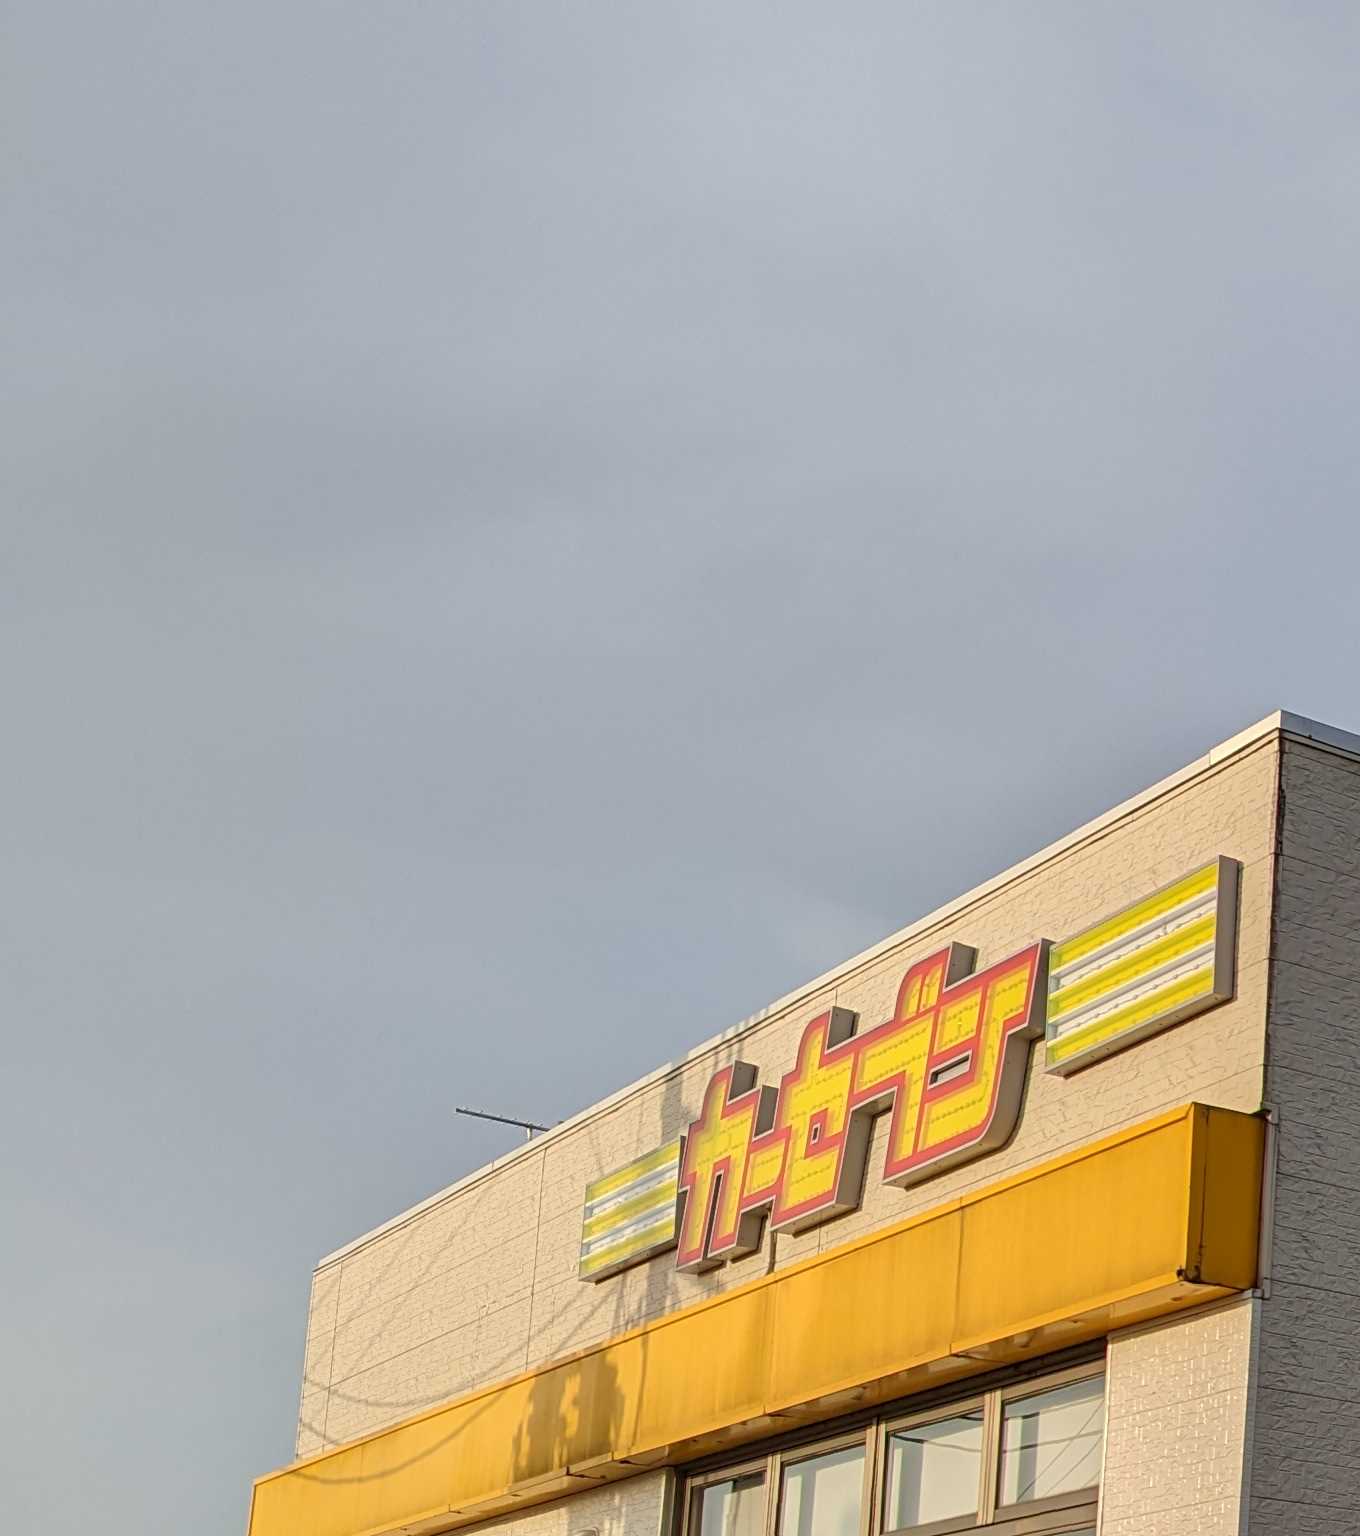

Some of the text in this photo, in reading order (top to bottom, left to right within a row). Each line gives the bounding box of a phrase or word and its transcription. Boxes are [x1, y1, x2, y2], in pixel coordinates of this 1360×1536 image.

[676, 939, 1046, 1272] カーセブン
